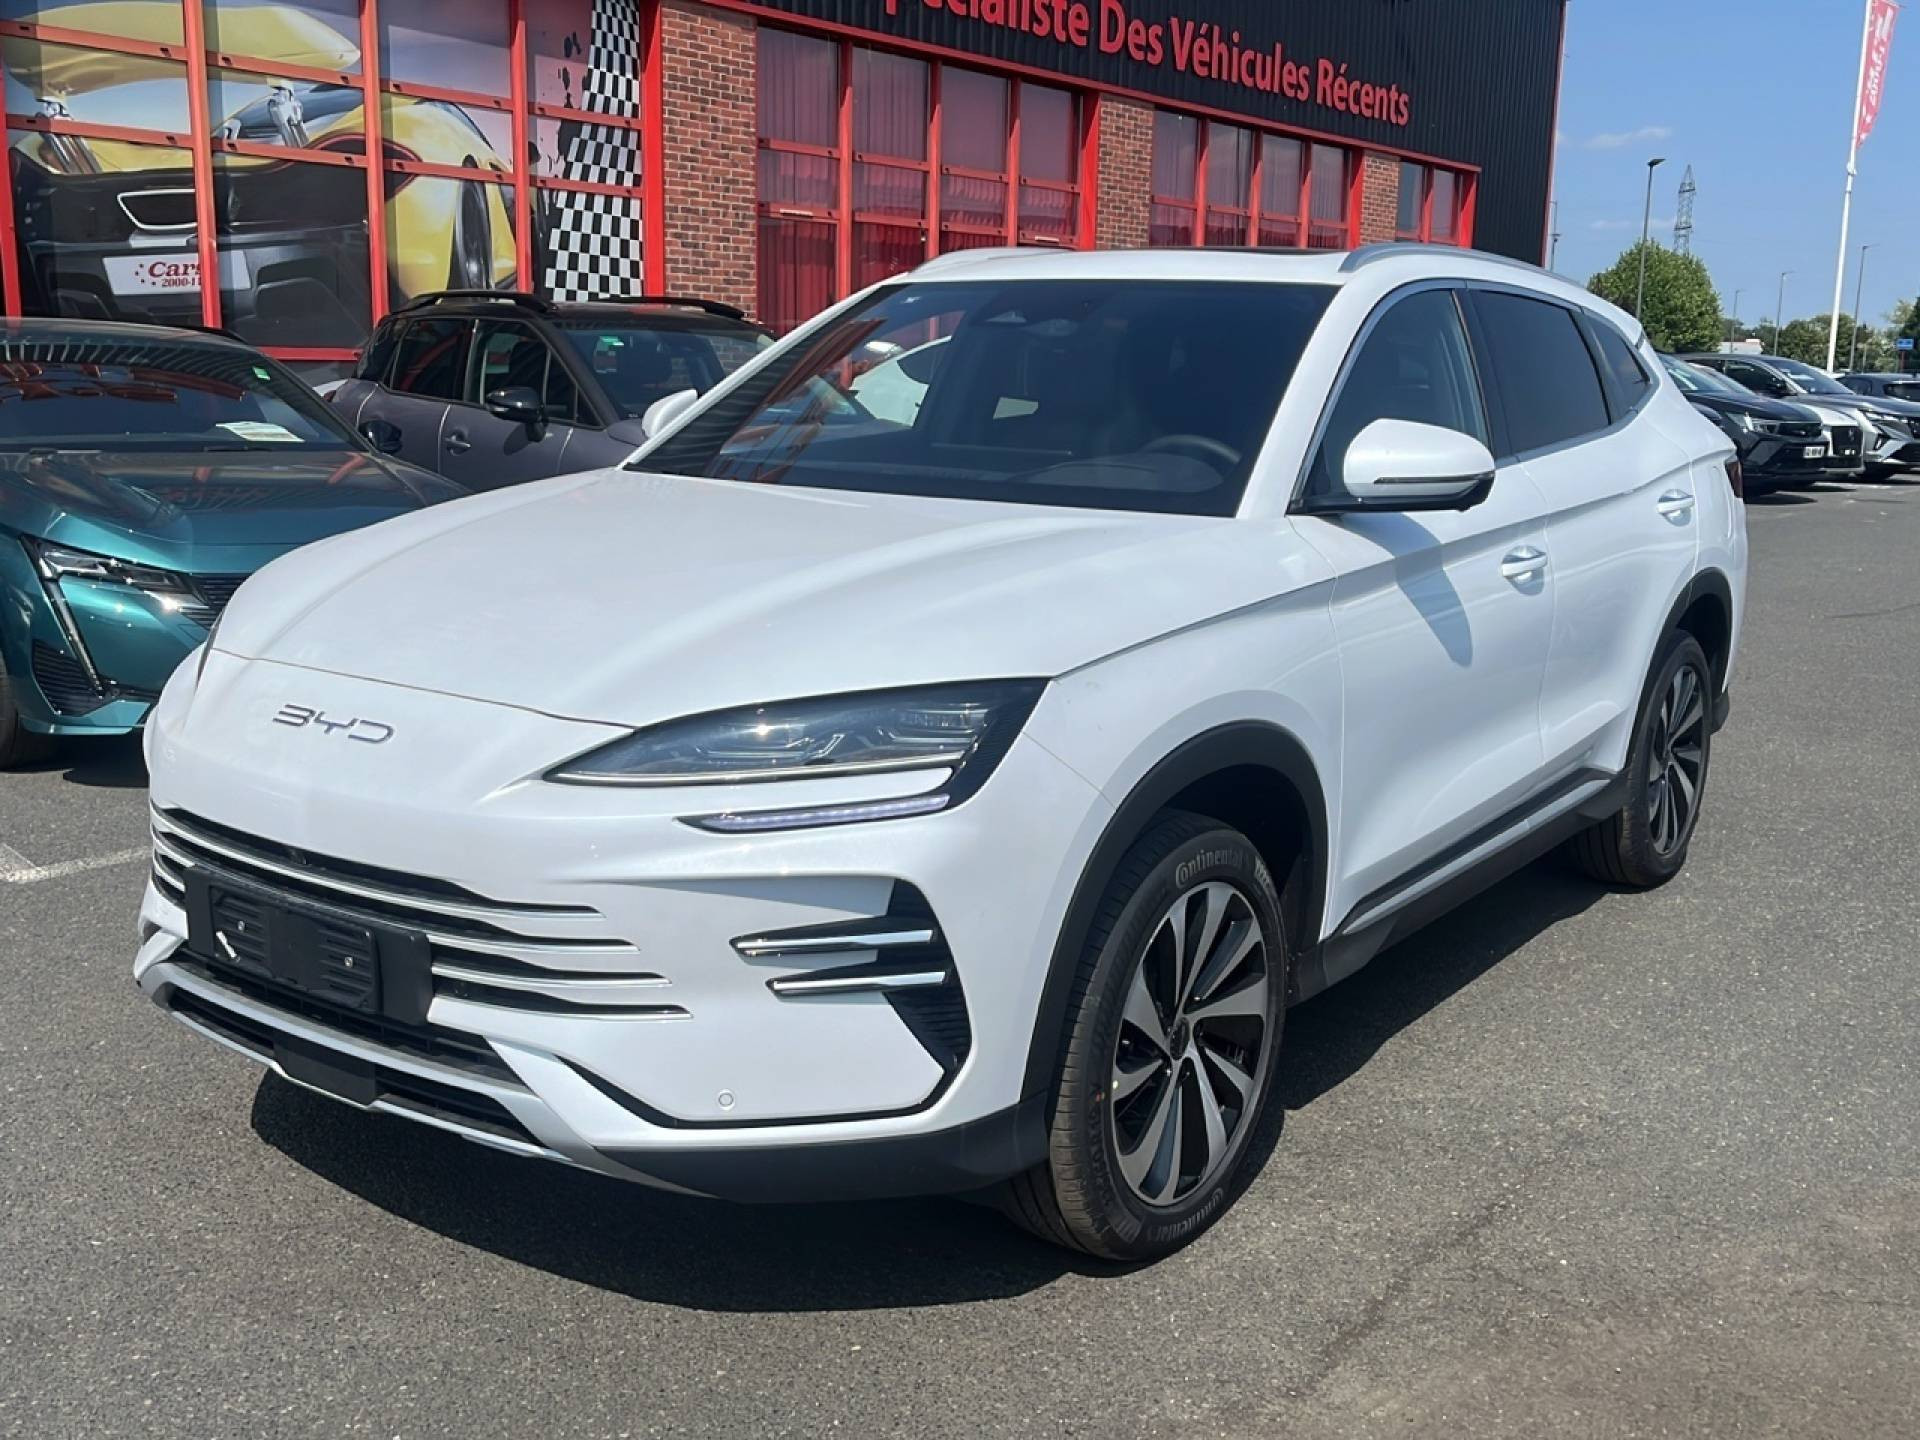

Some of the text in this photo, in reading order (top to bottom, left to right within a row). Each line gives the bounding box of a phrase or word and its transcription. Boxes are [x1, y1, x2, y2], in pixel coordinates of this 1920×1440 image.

[1100, 0, 1163, 65] Des
[1170, 16, 1310, 101] Véhicules
[1317, 58, 1409, 125] Récents
[272, 704, 394, 744] BYD
